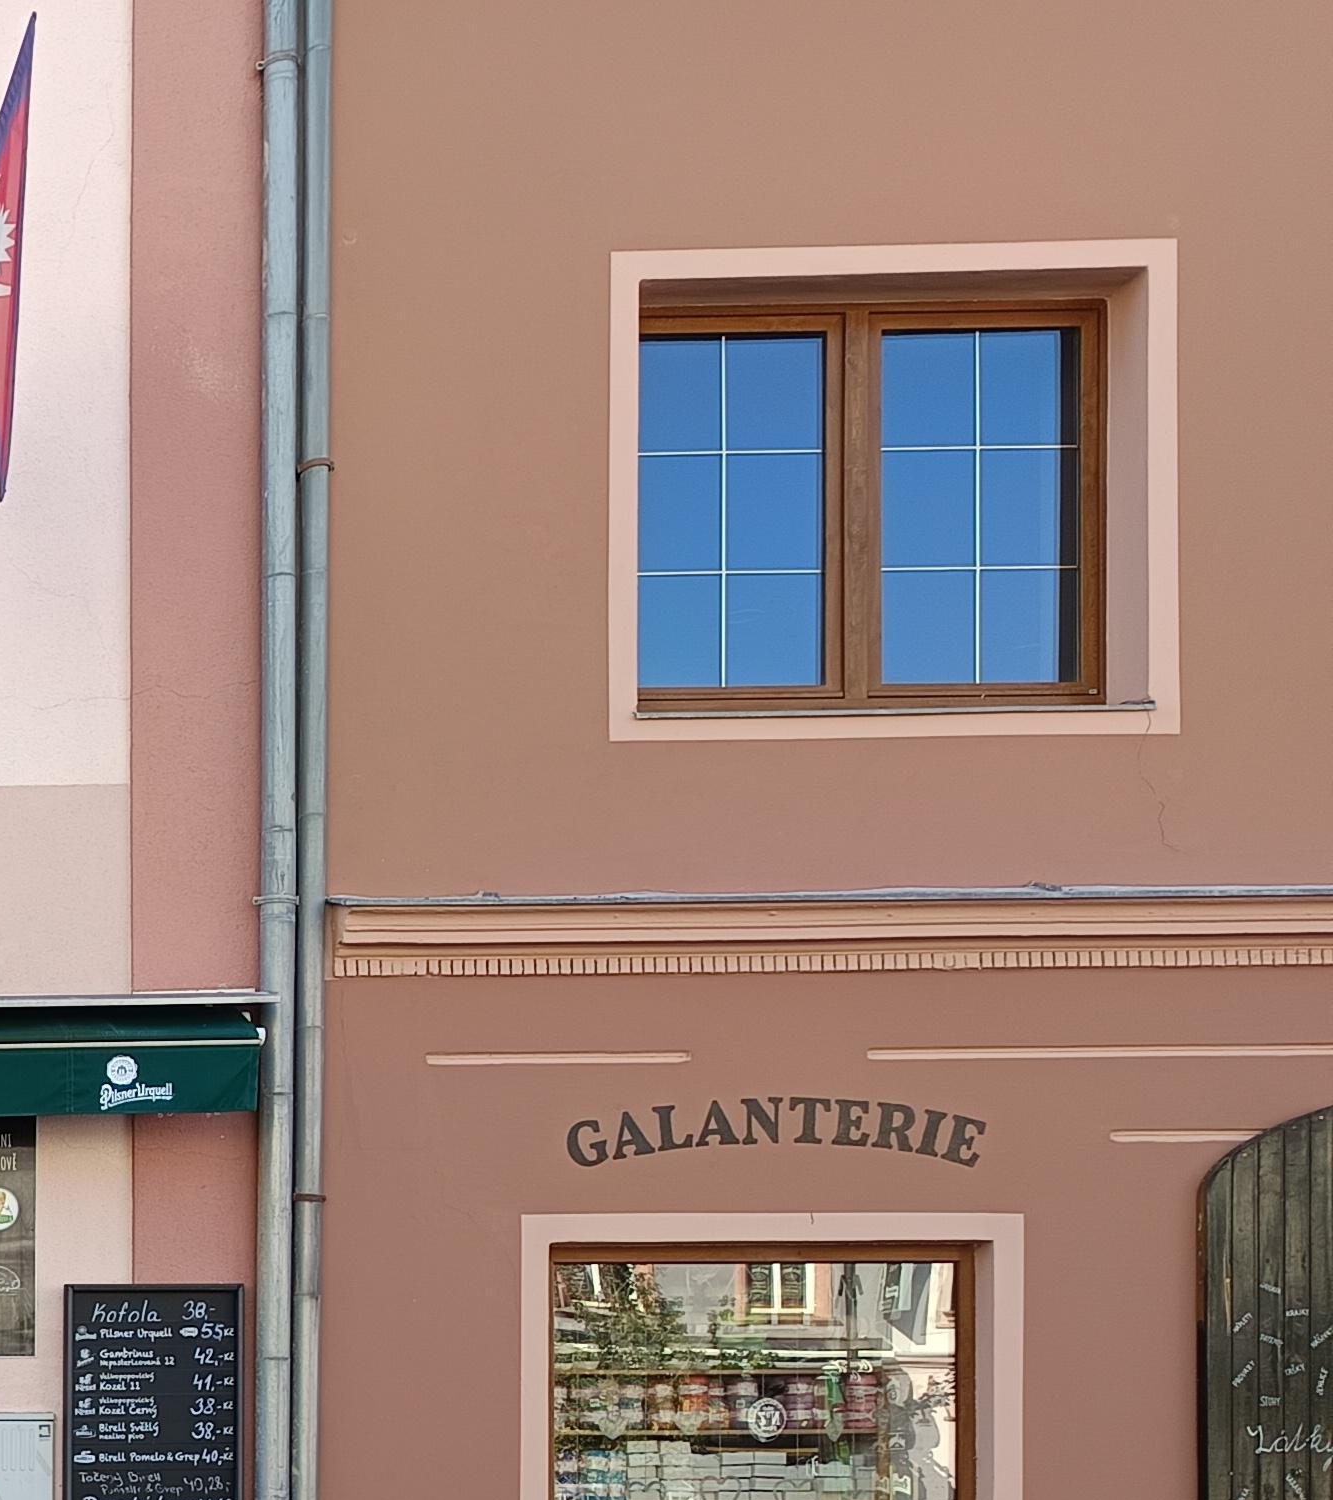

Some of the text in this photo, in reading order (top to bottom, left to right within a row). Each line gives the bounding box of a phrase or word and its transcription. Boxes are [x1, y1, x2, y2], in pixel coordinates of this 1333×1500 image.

[566, 1096, 987, 1168] GALANTERIE
[91, 1300, 161, 1323] Kofola
[100, 1328, 135, 1339] Pilsner
[137, 1328, 173, 1342] Urquell
[100, 1347, 154, 1359] Gambrinus
[100, 1381, 127, 1391] Kozel
[99, 1405, 126, 1415] Kozel
[129, 1403, 158, 1418] Černý
[99, 1422, 127, 1432] Birell
[130, 1421, 159, 1437] Světlý
[128, 1433, 145, 1443] pivo
[99, 1452, 127, 1462] Birell
[130, 1452, 166, 1462] Pomelo
[175, 1452, 200, 1466] Grep
